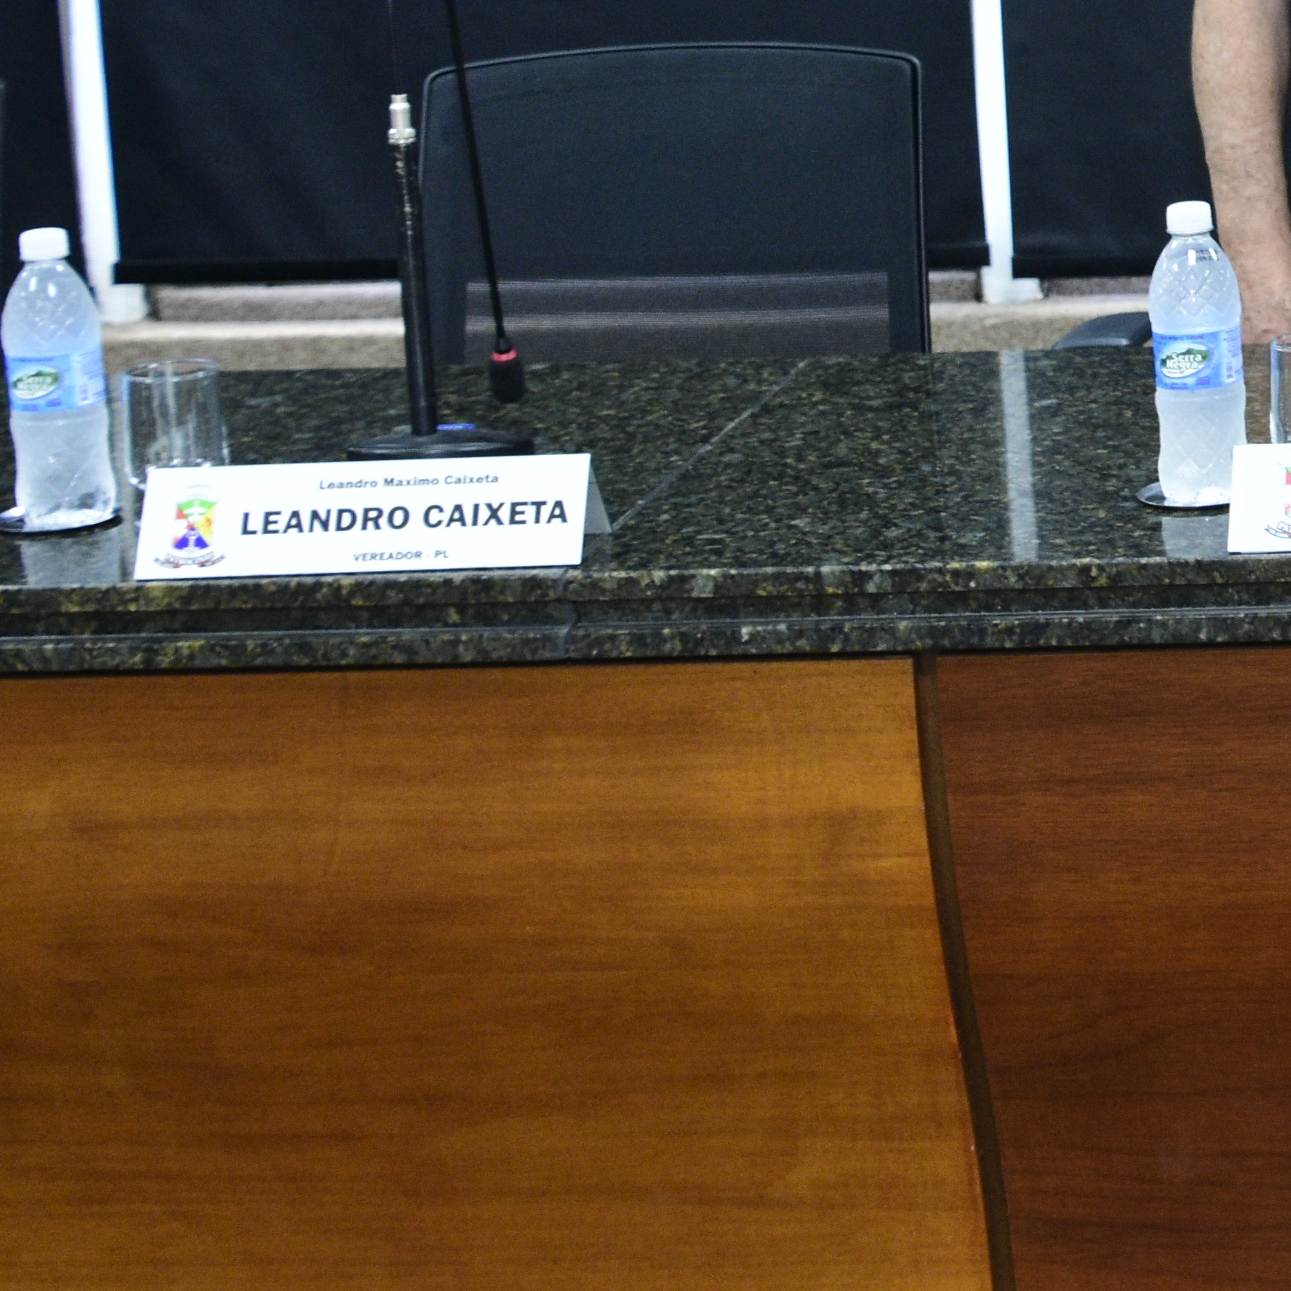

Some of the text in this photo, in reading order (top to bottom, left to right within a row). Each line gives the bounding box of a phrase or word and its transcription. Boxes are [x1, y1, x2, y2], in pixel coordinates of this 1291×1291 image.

[1171, 352, 1202, 362] Serra
[1166, 360, 1199, 370] Negra
[319, 472, 499, 491] Leandro Maximo Caixeta
[240, 499, 569, 536] LEANDRO CAIXETA
[353, 550, 423, 562] VEREADOR
[434, 549, 450, 560] PL
